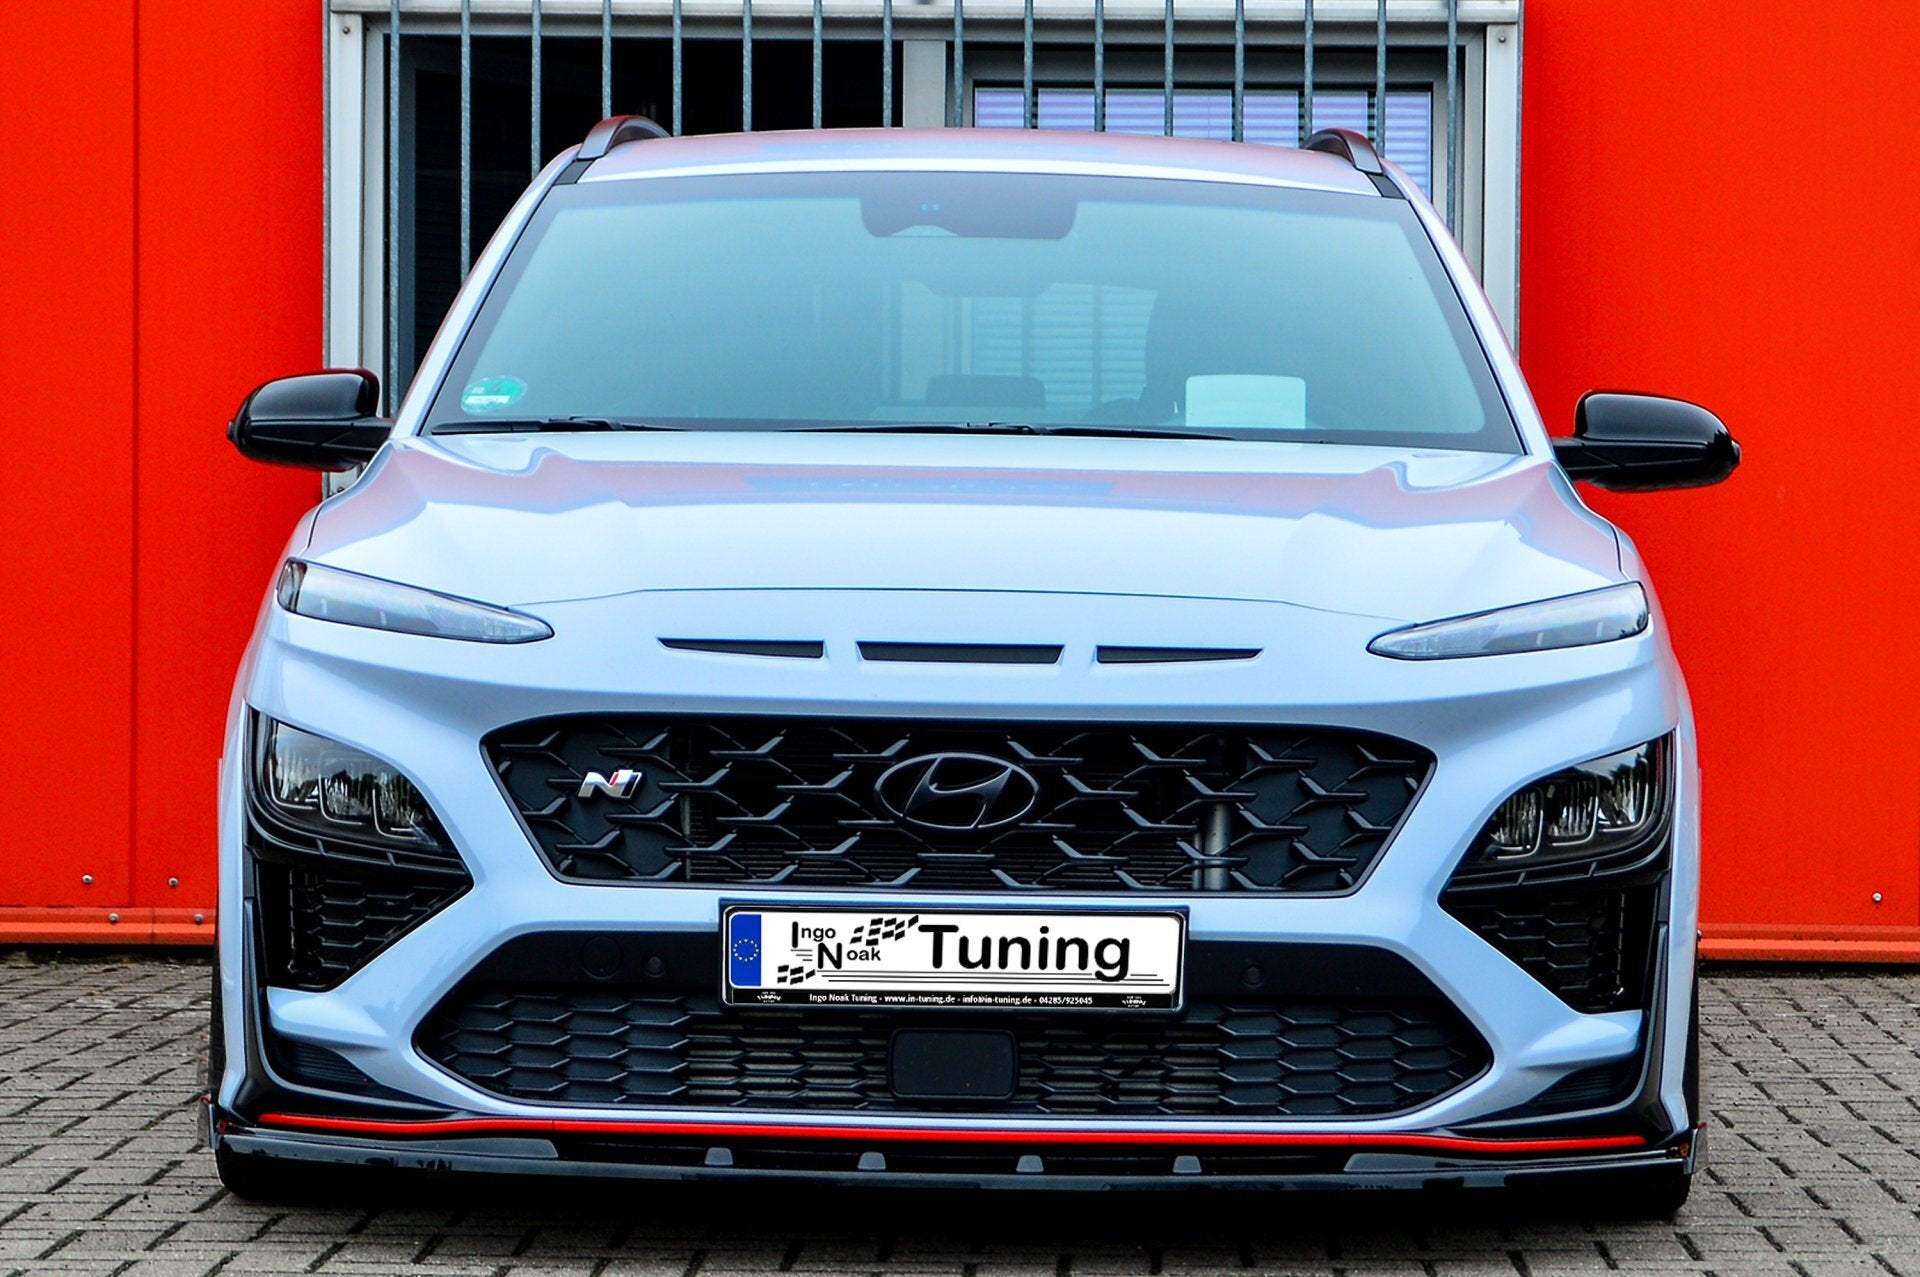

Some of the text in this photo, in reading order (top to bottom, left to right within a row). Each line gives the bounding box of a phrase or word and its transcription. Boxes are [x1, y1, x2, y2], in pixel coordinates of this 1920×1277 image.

[791, 921, 837, 948] Ingo
[818, 942, 882, 970] Noak
[918, 924, 1131, 982] Tuning
[809, 994, 1093, 1005] Ingo Noak Tuning www.in-tuning.de info@in-tuning.de 04285/925045
